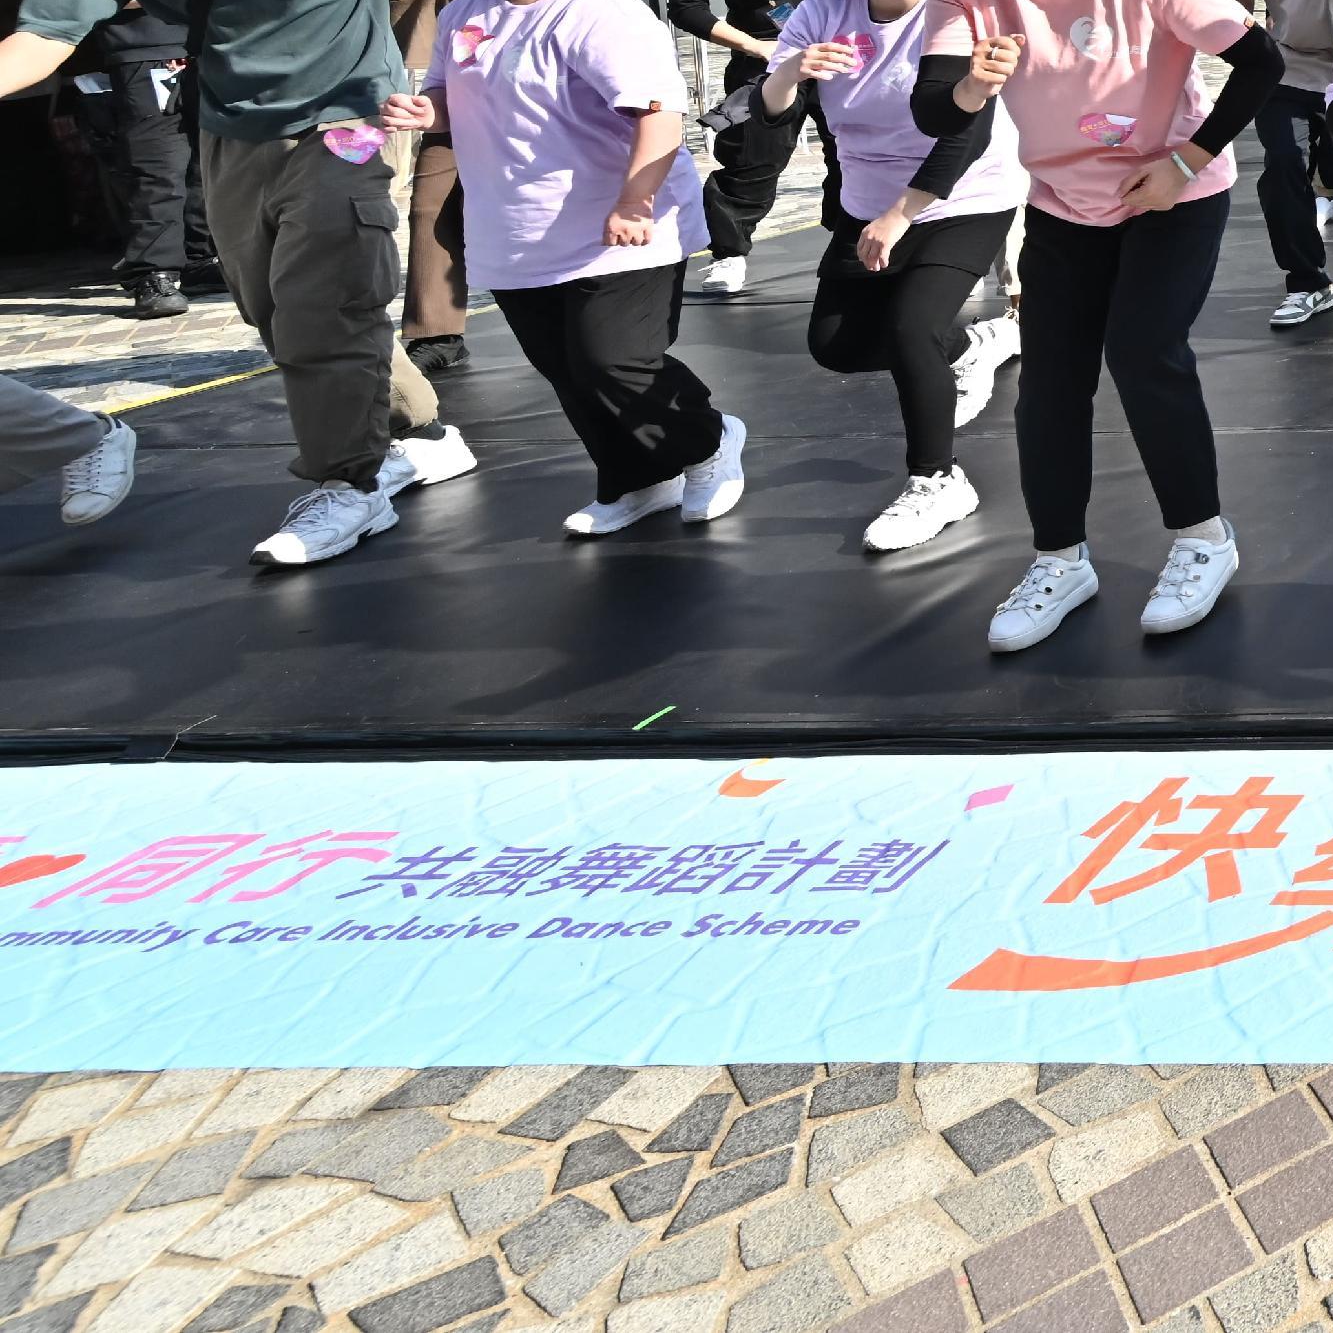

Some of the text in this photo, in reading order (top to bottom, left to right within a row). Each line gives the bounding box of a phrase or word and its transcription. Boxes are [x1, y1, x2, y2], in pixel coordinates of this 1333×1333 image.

[29, 831, 951, 909] 同行 共融舞蹈計劃
[0, 912, 862, 954] mmunity Care Inclusive Dance Scheme
